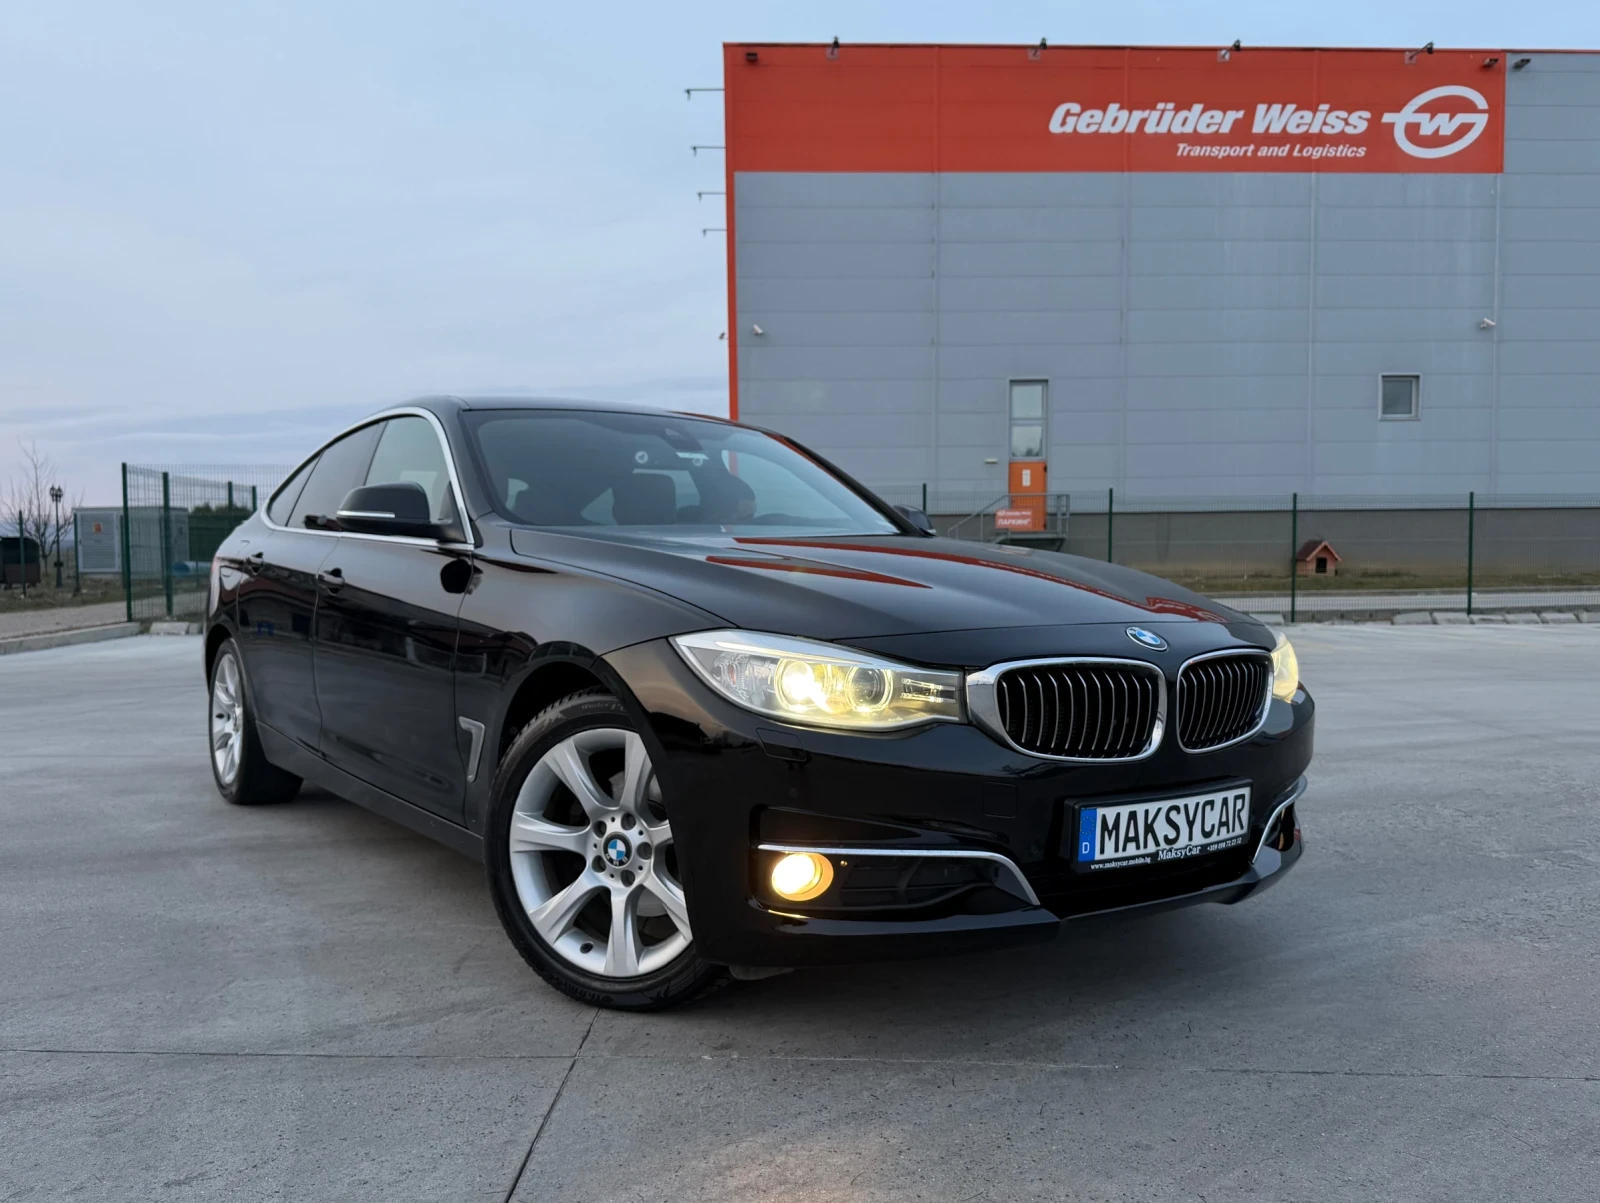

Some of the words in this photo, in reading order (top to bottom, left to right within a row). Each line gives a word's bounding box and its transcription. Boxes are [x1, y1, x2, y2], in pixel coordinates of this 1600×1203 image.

[1048, 102, 1245, 134] Gebrüder
[1252, 103, 1371, 134] Weiss
[1176, 143, 1254, 159] Transport
[1257, 143, 1290, 158] and
[1293, 144, 1366, 159] Logistics
[1100, 793, 1246, 855] MAKSYCAR
[1082, 842, 1090, 854] D
[1157, 845, 1201, 861] MaksyCar
